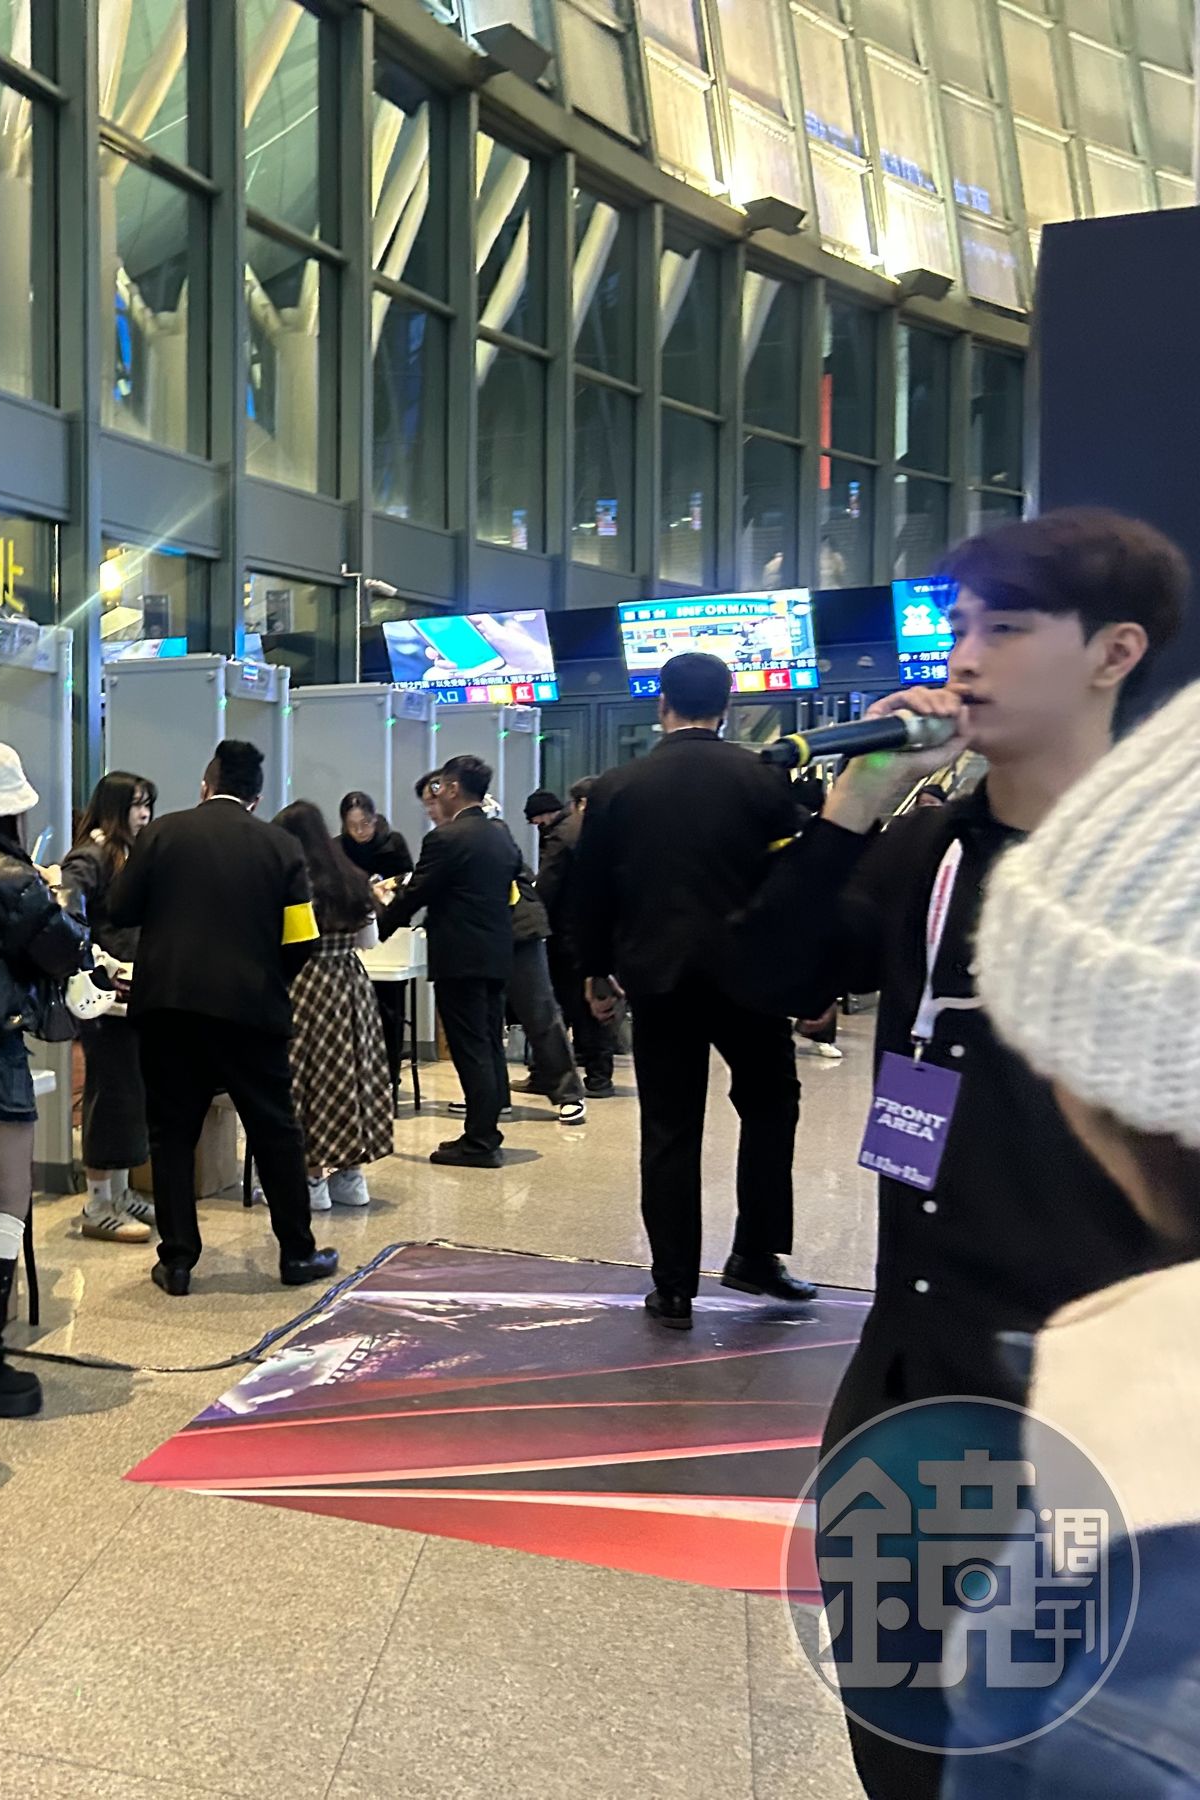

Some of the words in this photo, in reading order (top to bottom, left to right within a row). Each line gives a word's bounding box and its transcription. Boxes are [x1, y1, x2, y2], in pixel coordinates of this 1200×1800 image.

[435, 691, 459, 703] 入口
[633, 680, 660, 693] 1-3
[874, 1096, 947, 1129] FRONT
[876, 1113, 935, 1142] AREA
